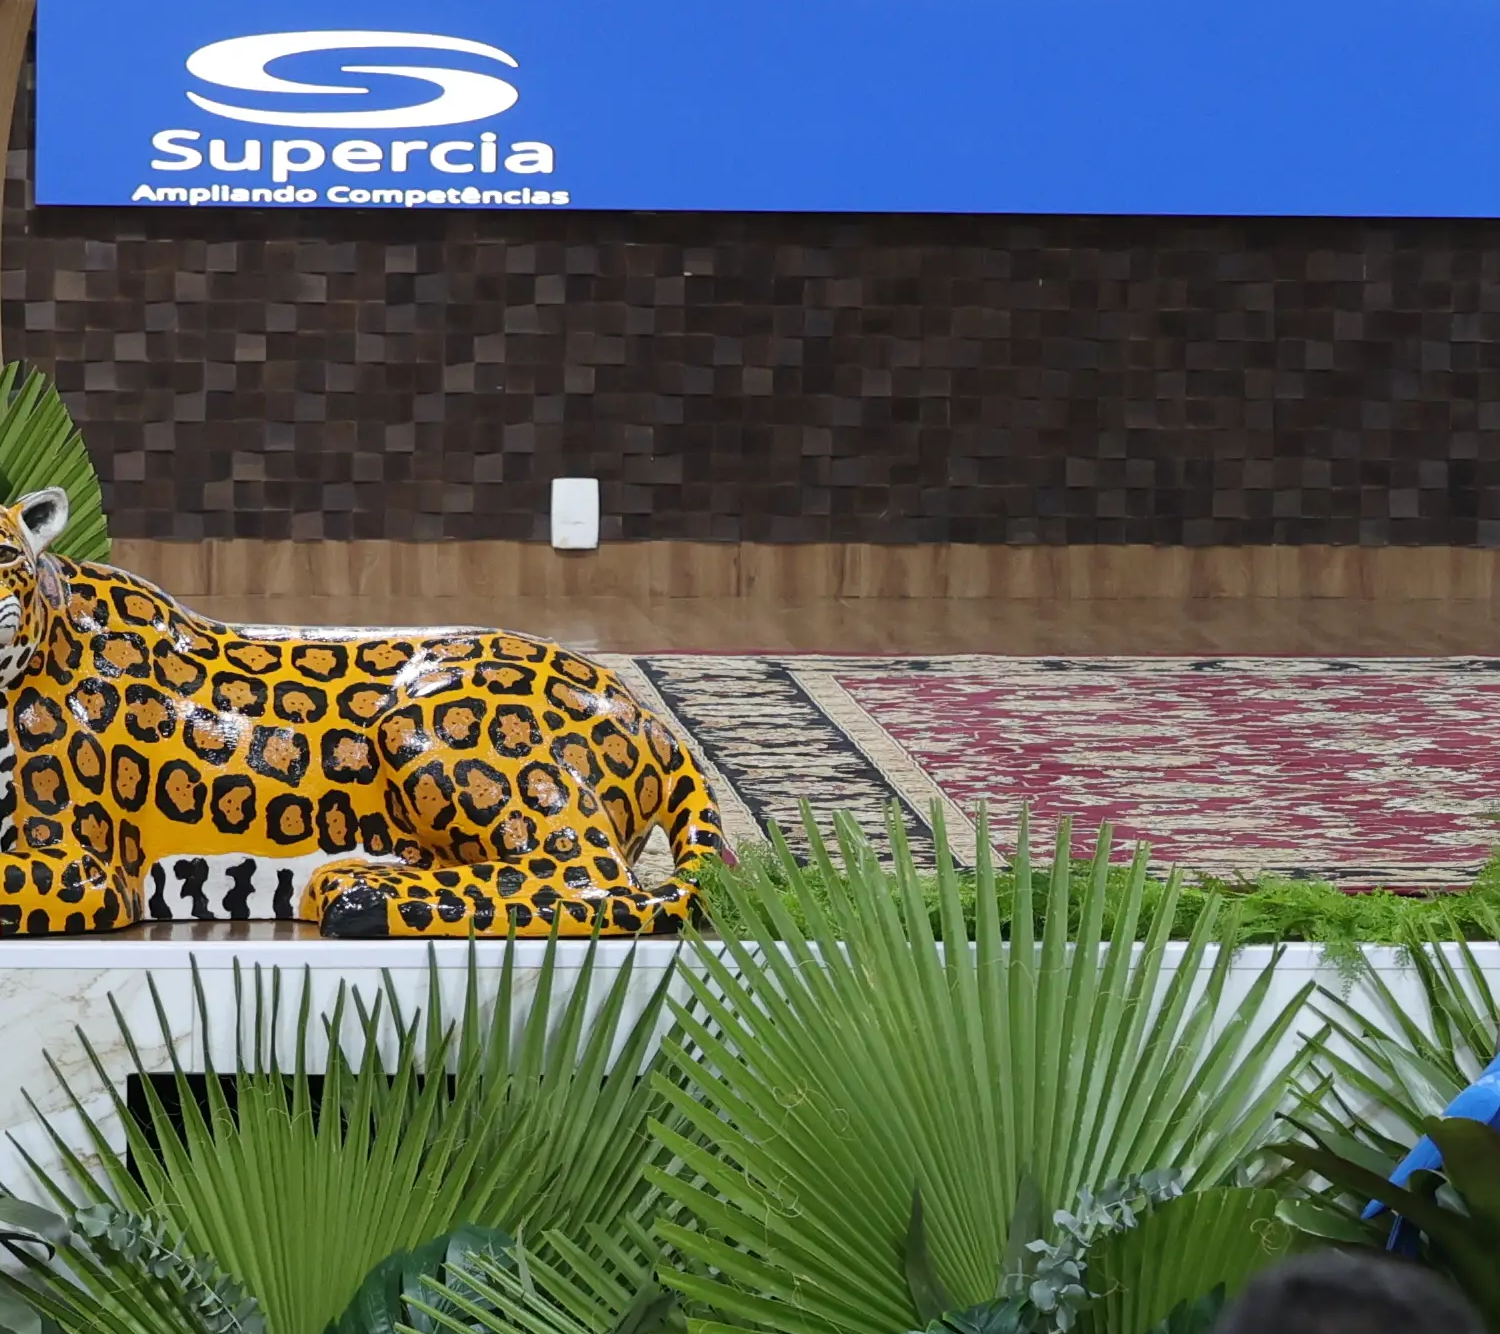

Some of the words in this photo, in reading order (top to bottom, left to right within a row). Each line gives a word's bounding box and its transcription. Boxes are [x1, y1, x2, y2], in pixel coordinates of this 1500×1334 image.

[151, 130, 553, 182] Supercia
[132, 184, 317, 206] Ampliando
[327, 185, 569, 208] Competências
